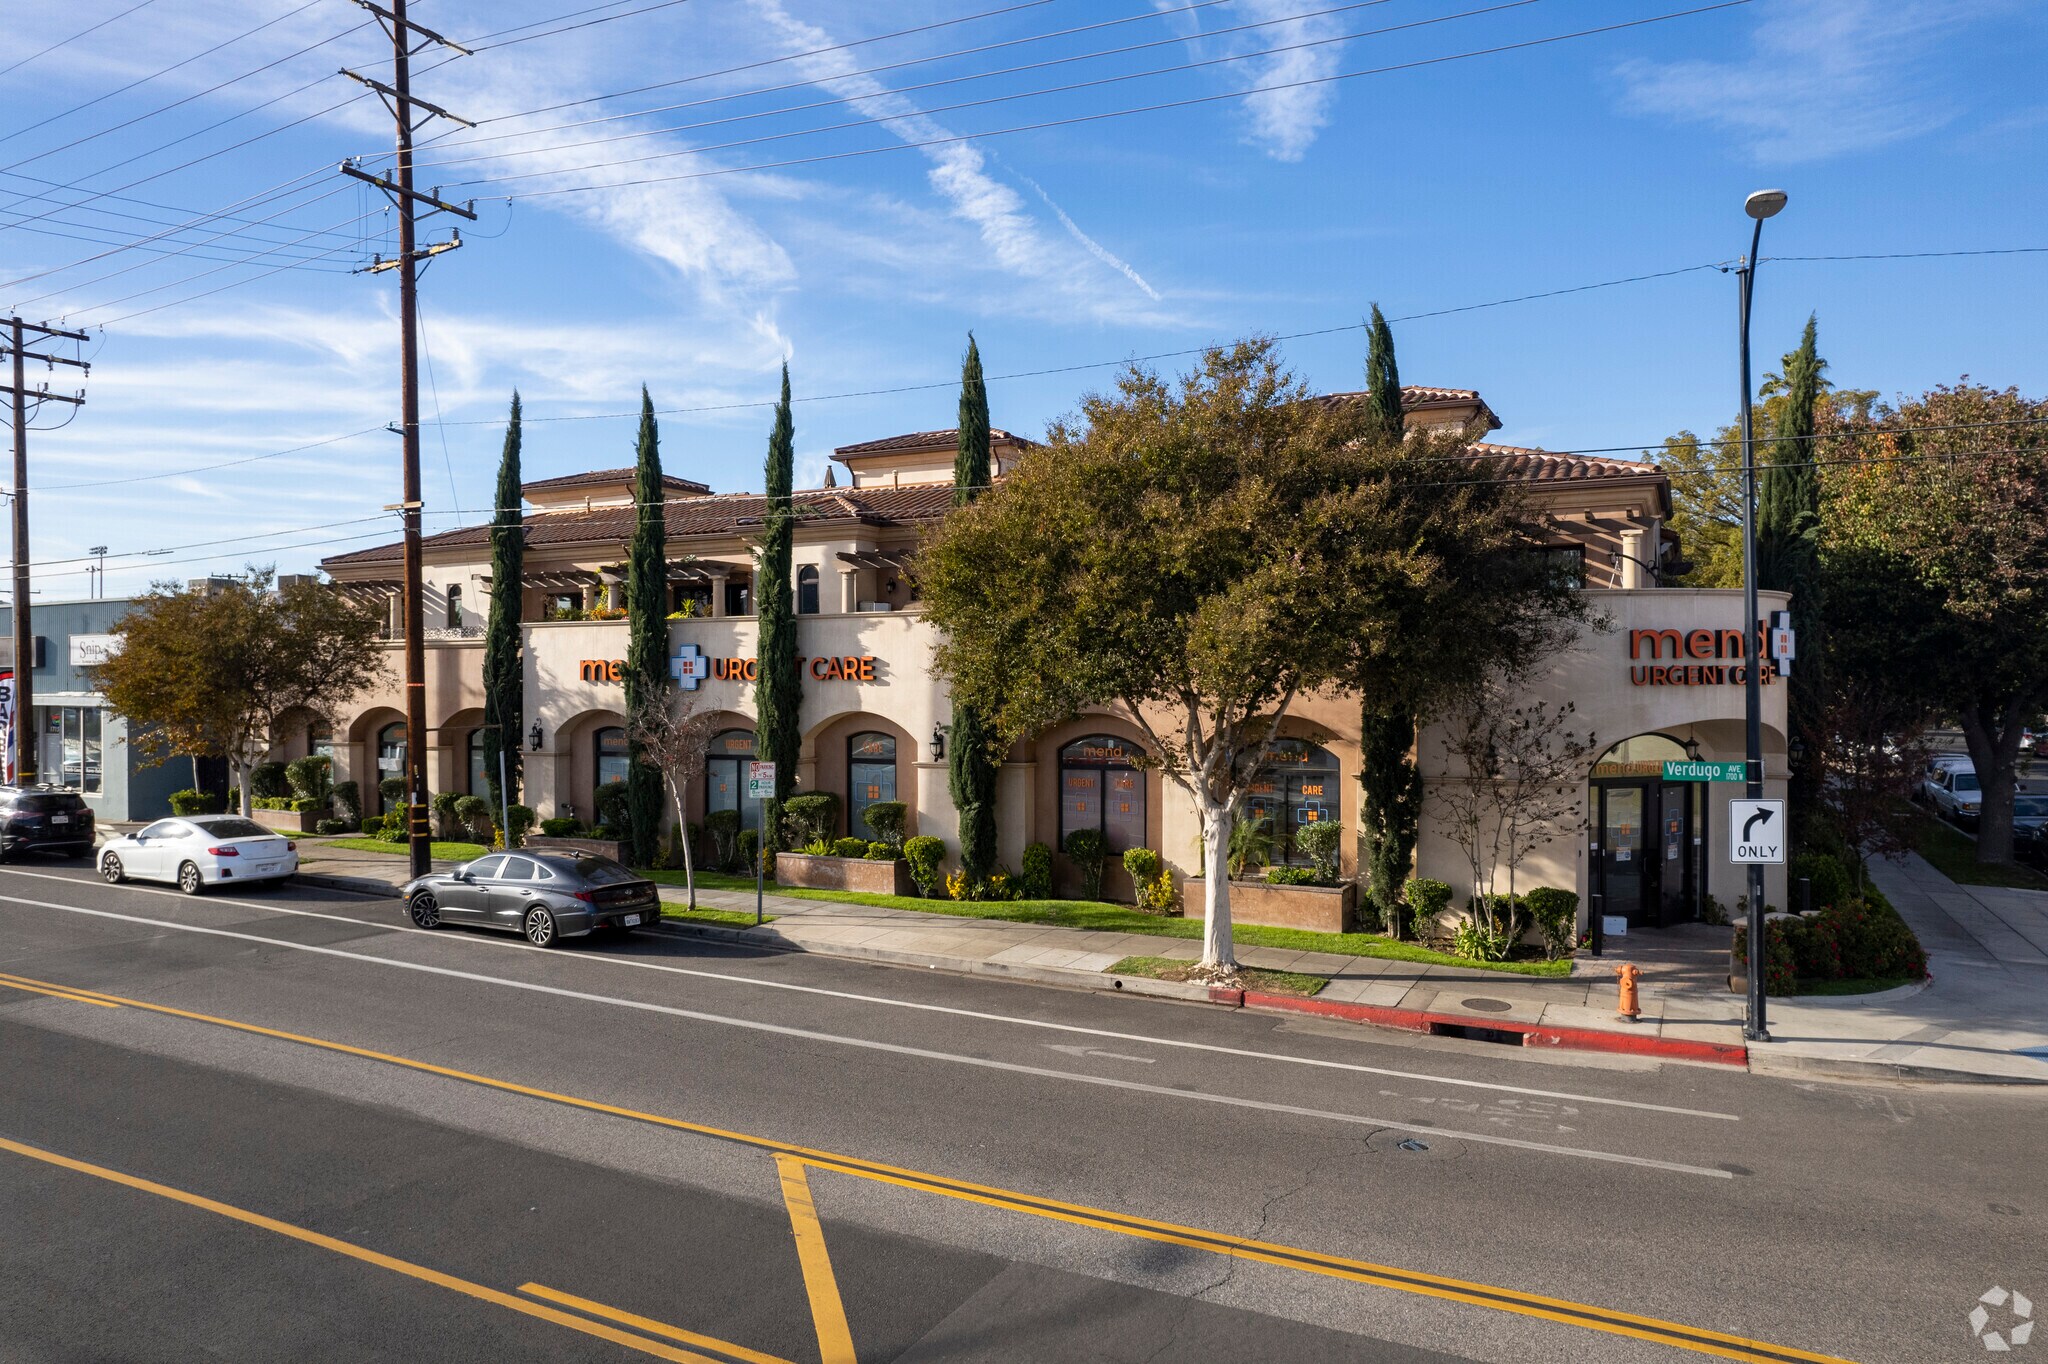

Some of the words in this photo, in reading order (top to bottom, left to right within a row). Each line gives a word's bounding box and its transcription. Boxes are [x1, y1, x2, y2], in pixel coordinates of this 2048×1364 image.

[579, 658, 622, 682] me
[712, 657, 806, 682] URGT
[809, 656, 874, 682] CARE
[1631, 665, 1729, 686] URGENT
[1731, 665, 1776, 686] CRE
[725, 739, 753, 750] URGENT
[863, 741, 883, 754] CARE
[1083, 745, 1122, 758] mend
[752, 763, 759, 772] NO
[1666, 762, 1721, 781] Verdugo
[1728, 765, 1741, 773] AVE
[1068, 778, 1095, 788] URGENT
[1725, 773, 1738, 781] 1700
[751, 781, 758, 789] 2
[1302, 785, 1323, 796] CARE
[1737, 845, 1778, 858] ONLY
